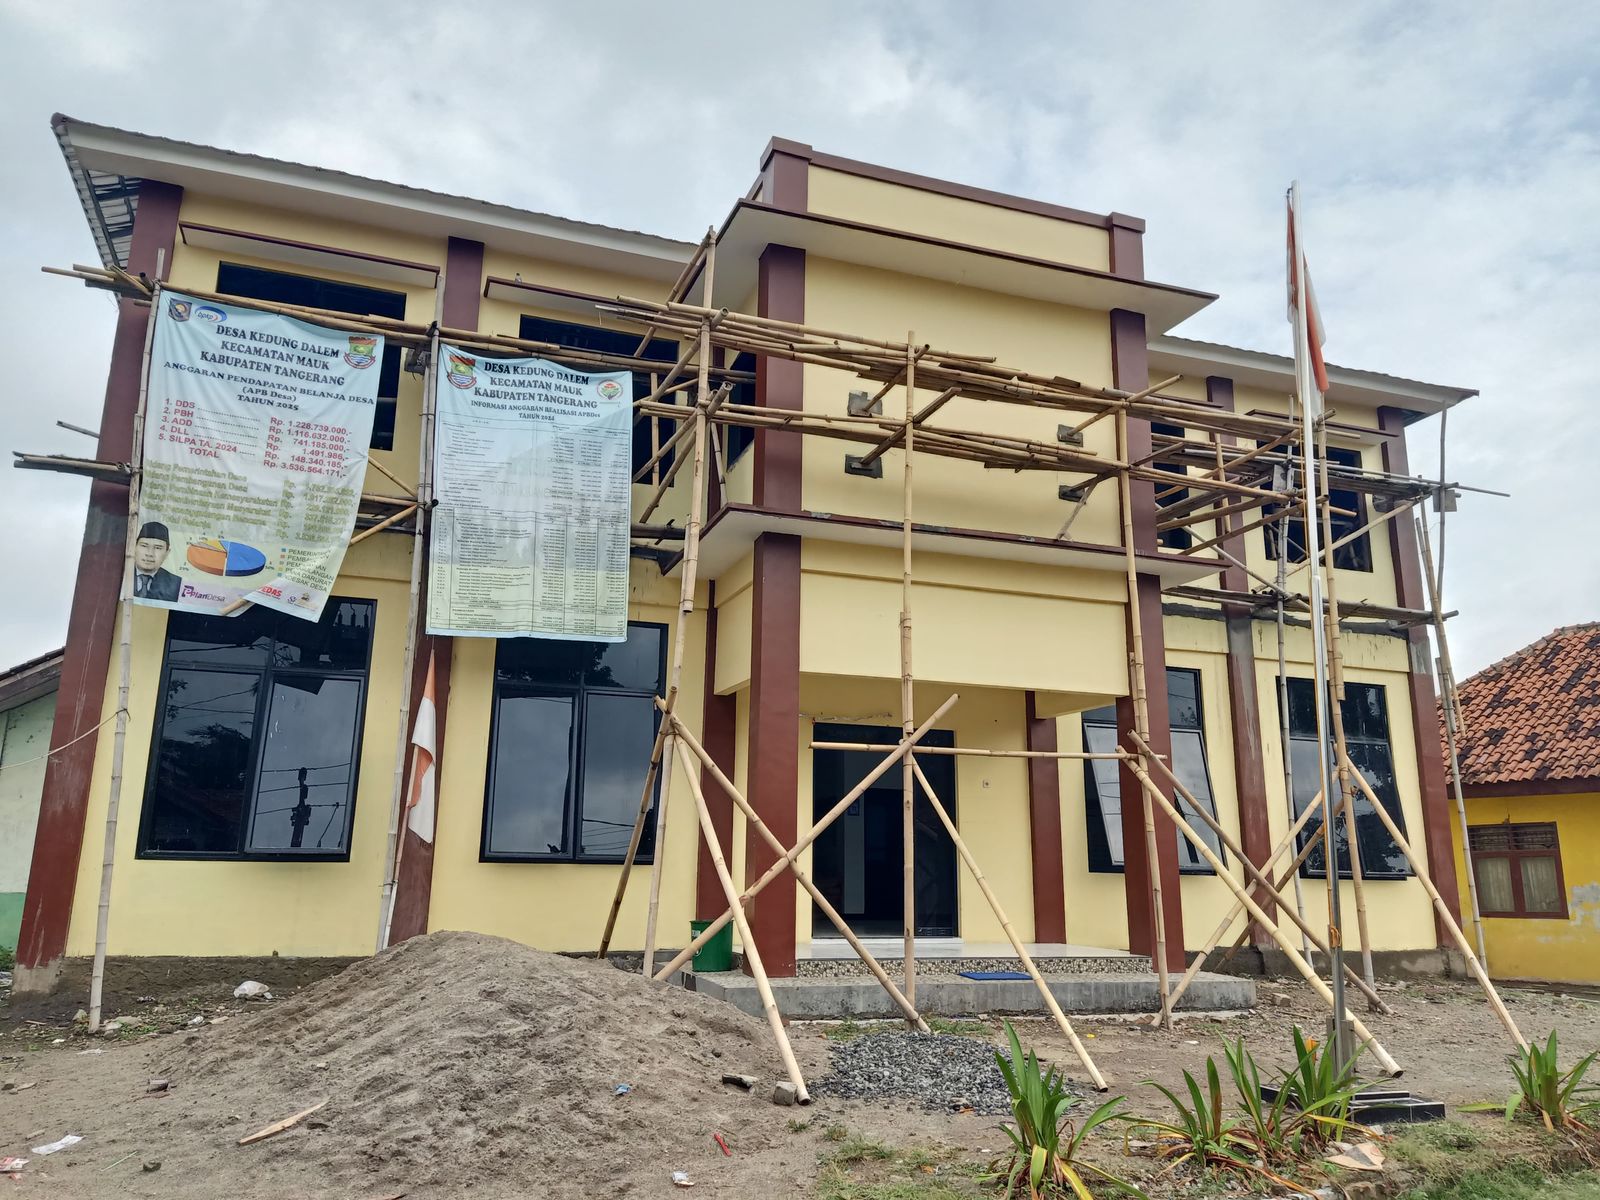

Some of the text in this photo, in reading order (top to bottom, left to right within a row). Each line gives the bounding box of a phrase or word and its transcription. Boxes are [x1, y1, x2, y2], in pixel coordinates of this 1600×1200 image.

[216, 324, 340, 358] DESA KEDUNG DALEM
[221, 340, 330, 370] KECAMATAN MAUK
[200, 351, 345, 386] KABUPATEN TANGERANG
[484, 361, 590, 385] DESA KEDUNG DALEM
[163, 361, 375, 405] ANGGARAN PENDAPATAN BELANJA DESA
[242, 386, 297, 402] (APB Desa)
[490, 376, 583, 396] KECAMATAN MAUK
[237, 394, 299, 411] TAHUN 2025
[471, 400, 507, 410] INFORMASI
[474, 387, 598, 409] KABUPATEN TANGERANG
[163, 407, 171, 415] 2.
[174, 408, 194, 418] PBH
[269, 426, 284, 435] Rp.
[175, 399, 195, 409] DDS
[270, 417, 285, 426] Rp.
[518, 412, 540, 420] TAHUN
[161, 415, 170, 424] 3.
[171, 417, 192, 427] ADD
[267, 434, 283, 443] Rp.
[170, 426, 190, 435] DLL
[266, 442, 281, 451] Rp.
[158, 433, 166, 441] 5.
[168, 434, 197, 446] SILPA
[215, 442, 237, 453] 2024
[264, 451, 280, 459] Rp.
[189, 447, 220, 458] TOTAL
[263, 459, 279, 468] Rp.
